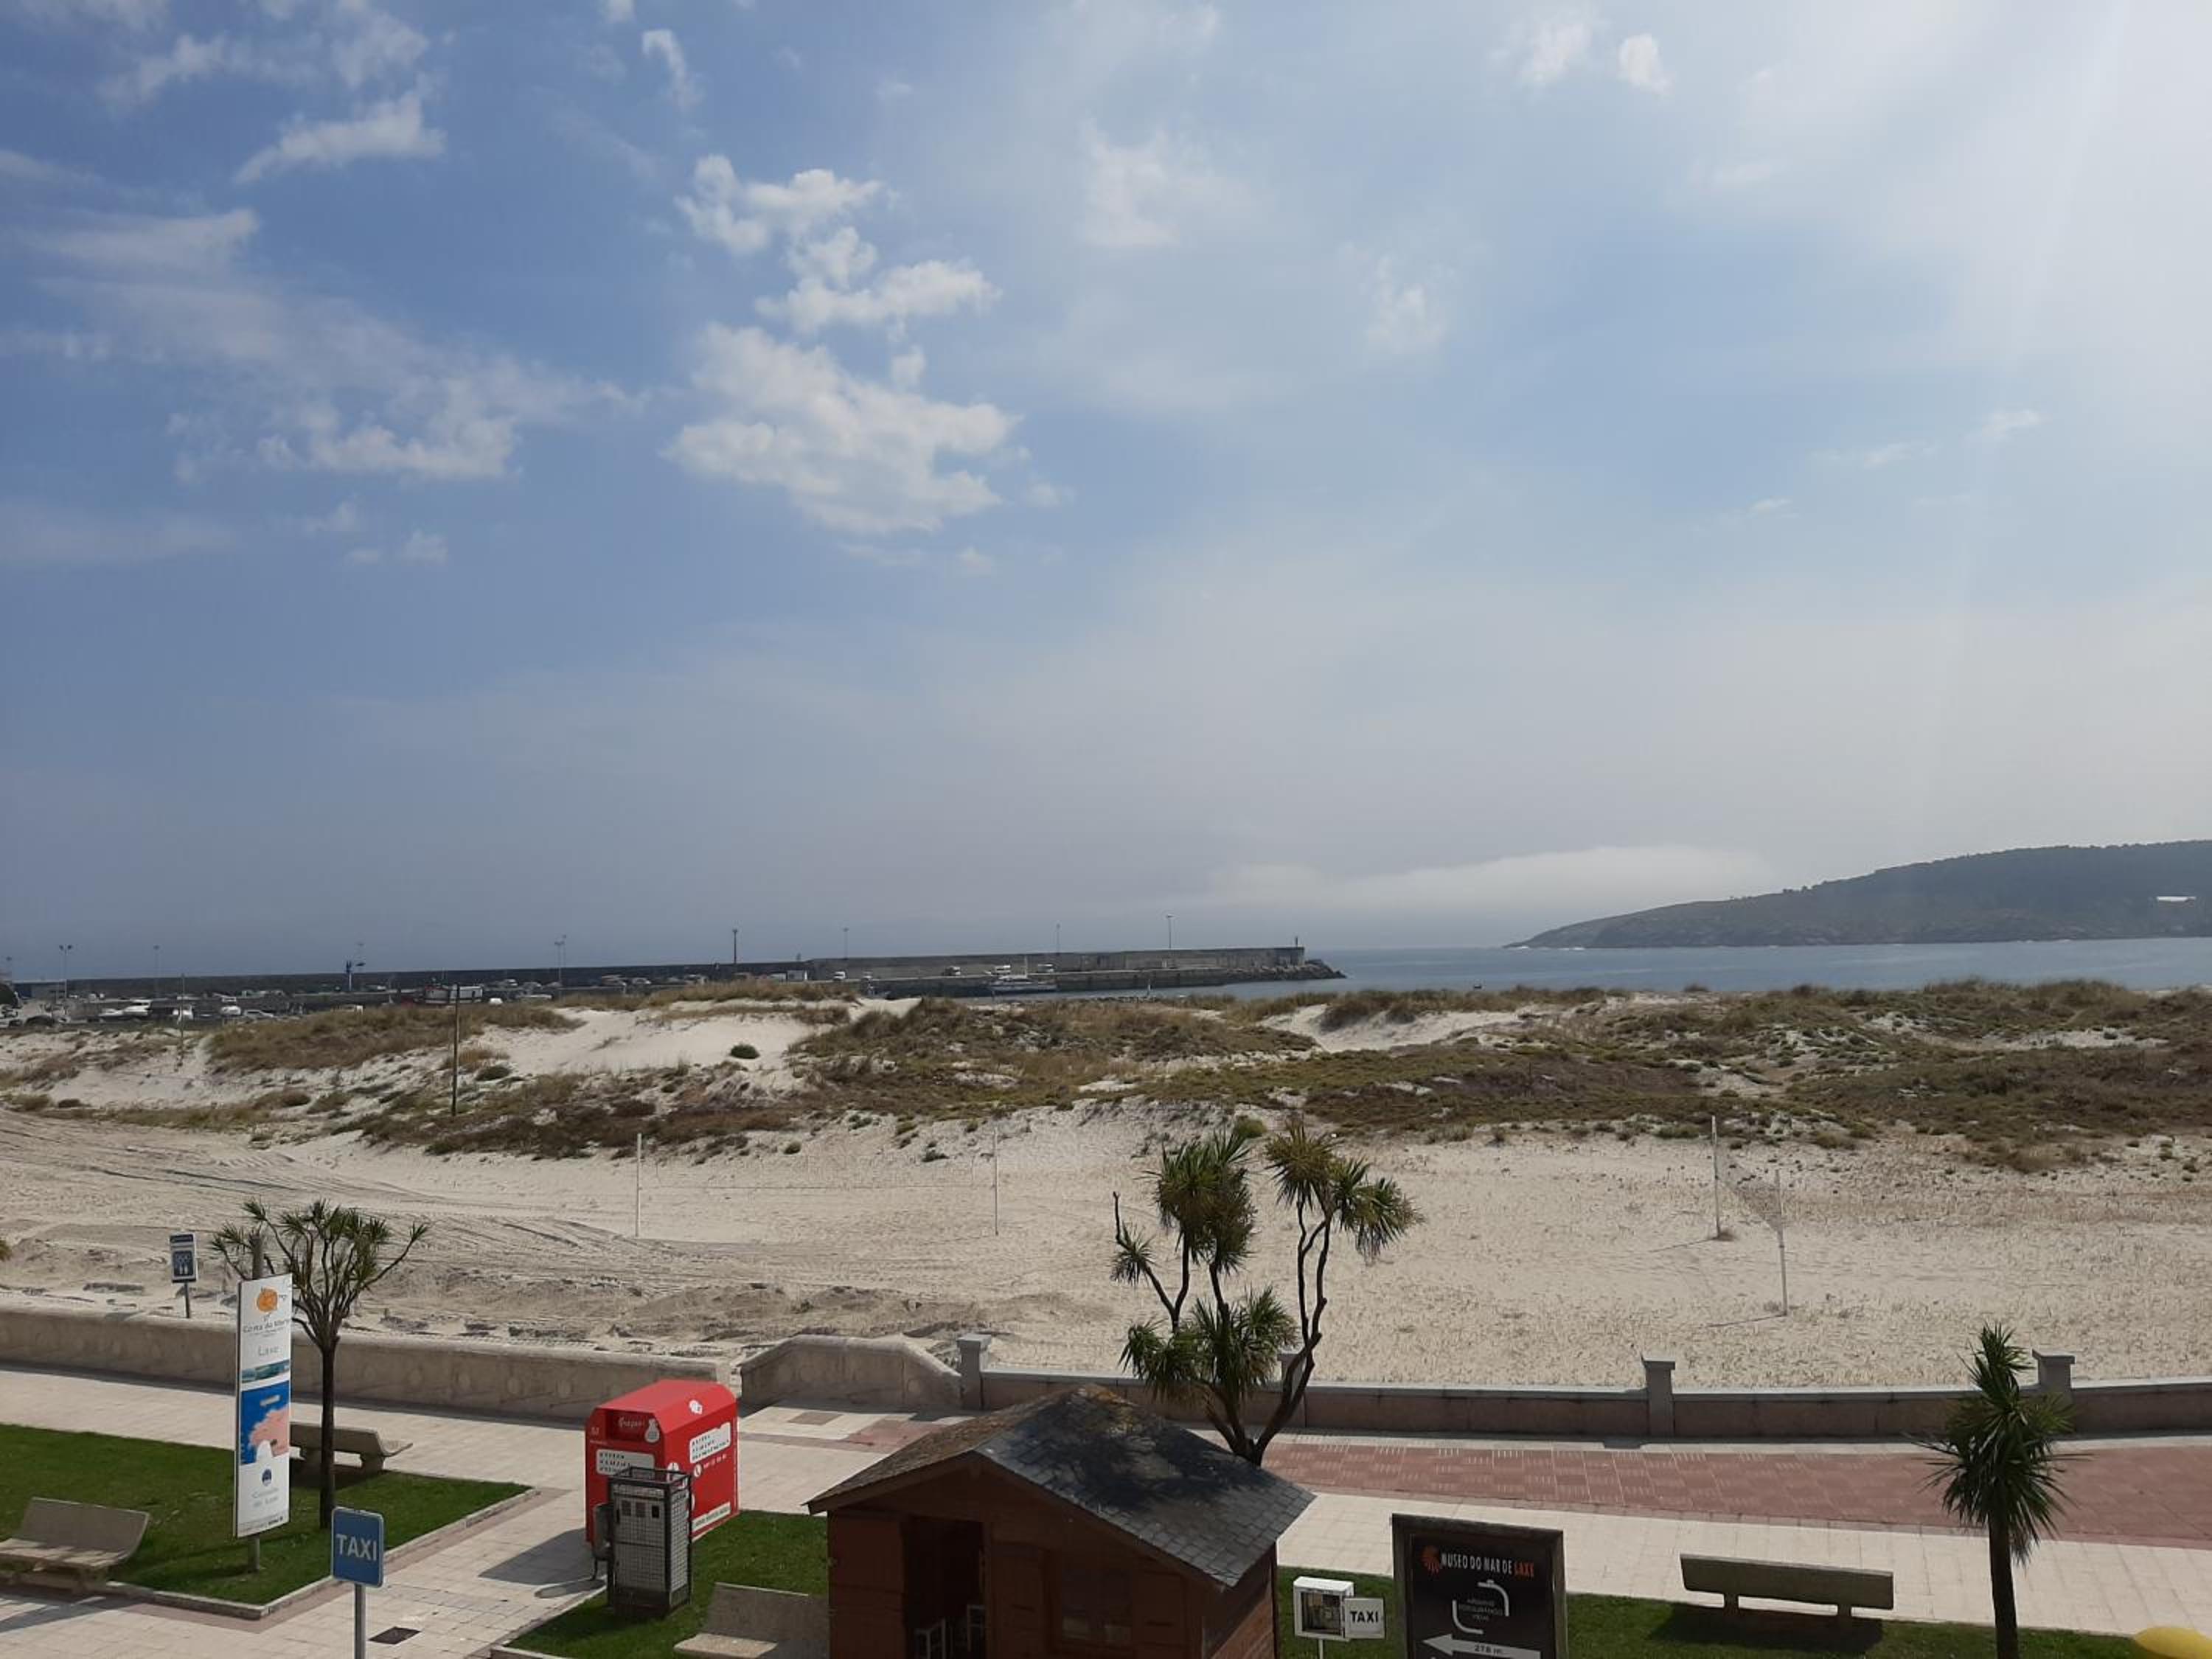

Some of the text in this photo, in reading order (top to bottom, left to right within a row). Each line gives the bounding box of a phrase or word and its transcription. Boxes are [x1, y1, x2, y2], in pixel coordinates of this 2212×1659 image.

[335, 1533, 377, 1561] TAXI
[1441, 1552, 1468, 1569] MUSEO
[1470, 1556, 1481, 1571] DO
[1484, 1557, 1500, 1573] MAR
[1502, 1559, 1512, 1574] DE
[1349, 1610, 1379, 1623] TAXI
